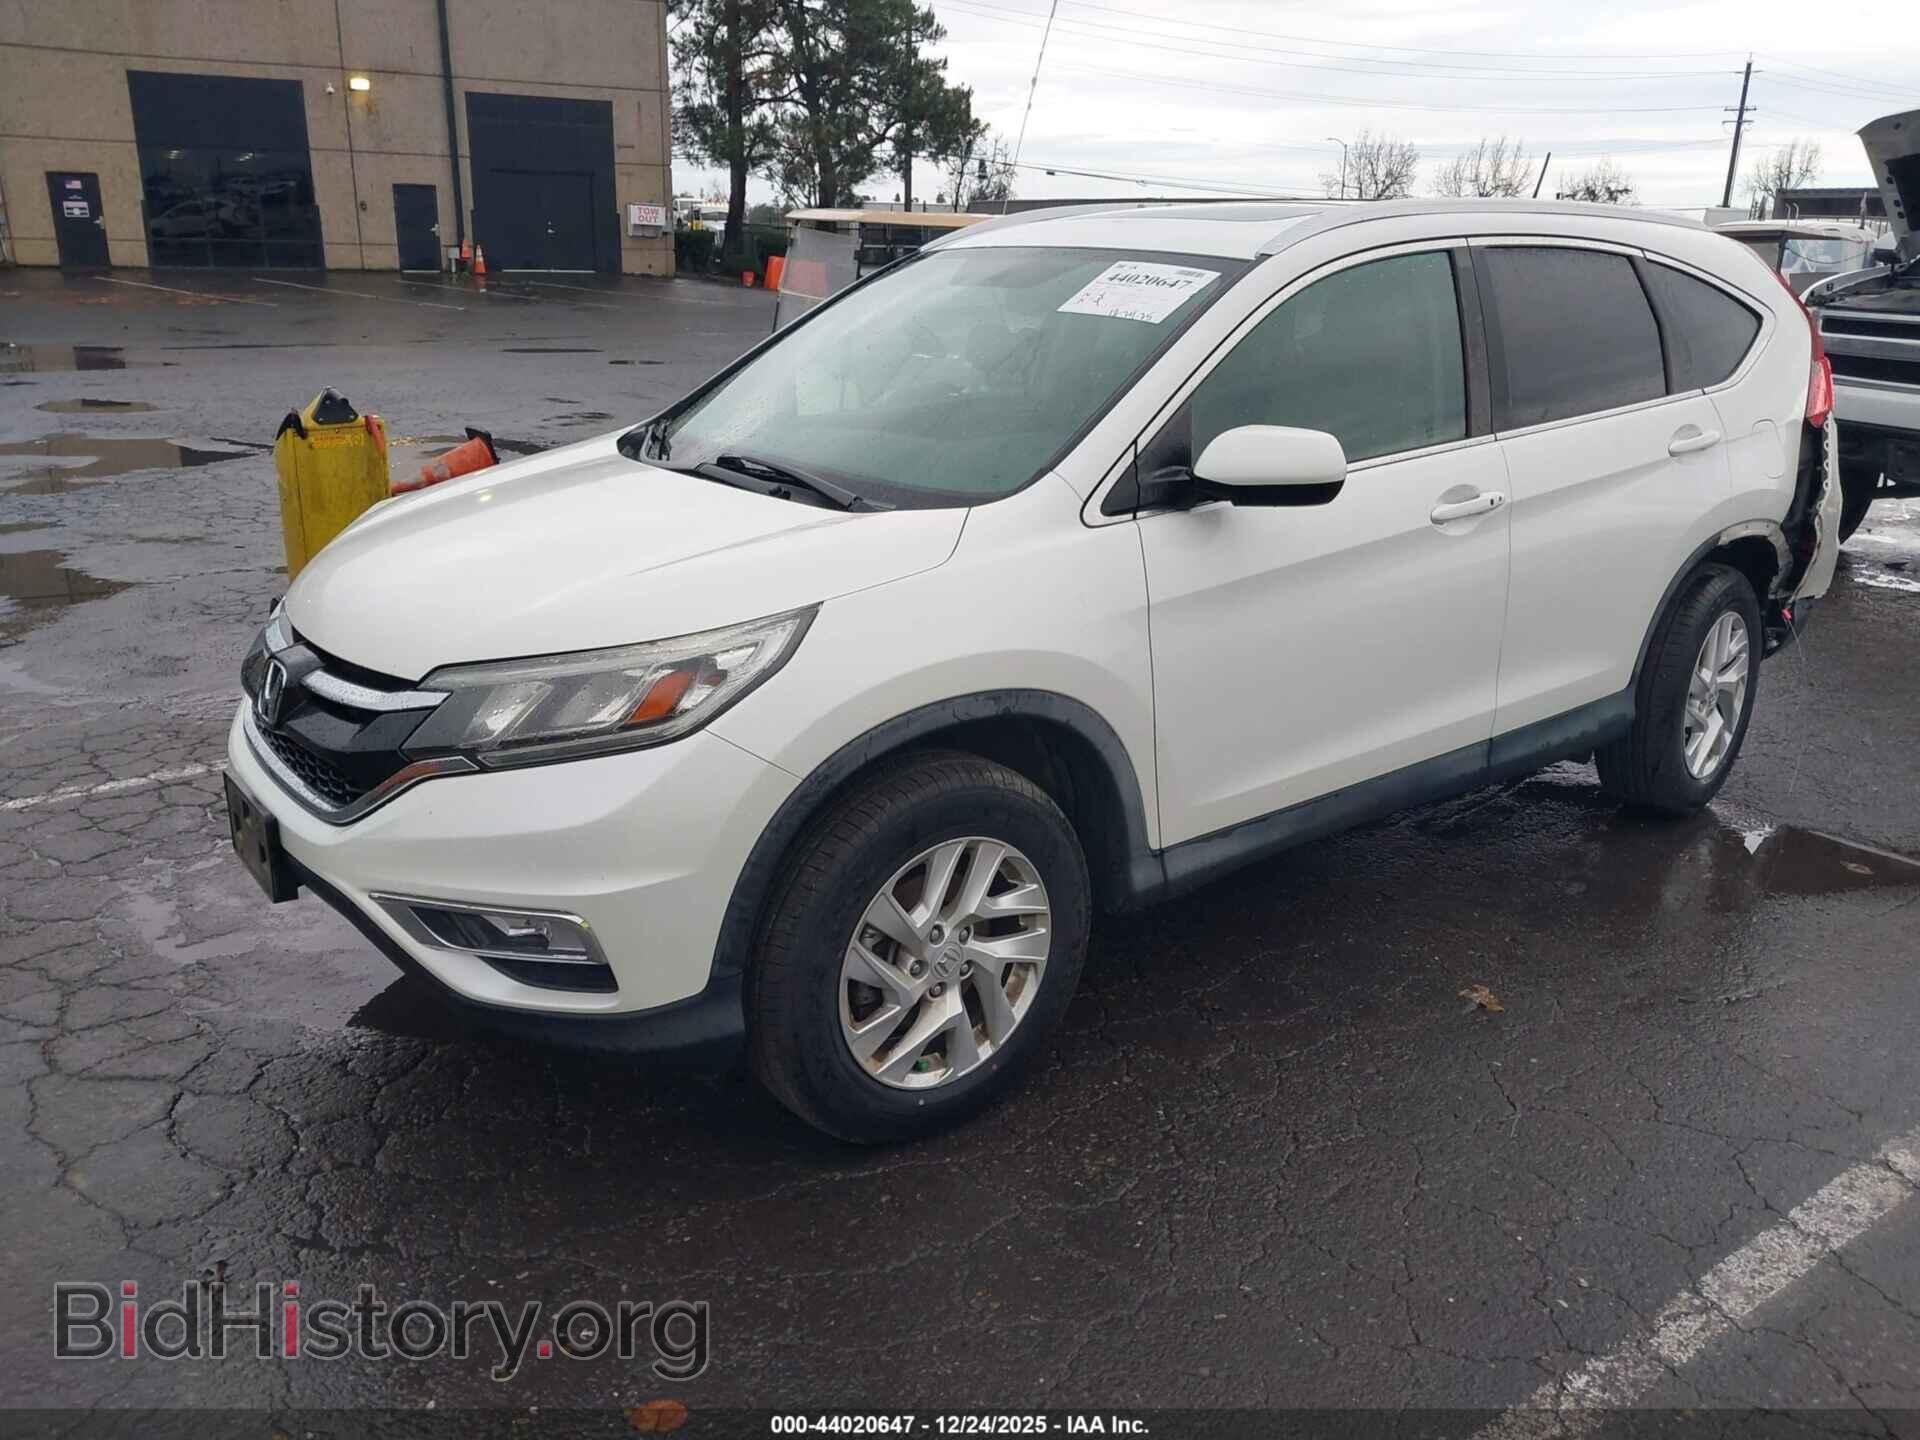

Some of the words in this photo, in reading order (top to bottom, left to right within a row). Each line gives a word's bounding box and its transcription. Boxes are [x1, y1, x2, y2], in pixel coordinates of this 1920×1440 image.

[638, 207, 660, 215] TOW
[638, 214, 658, 223] OUT
[1107, 272, 1193, 289] 44020647
